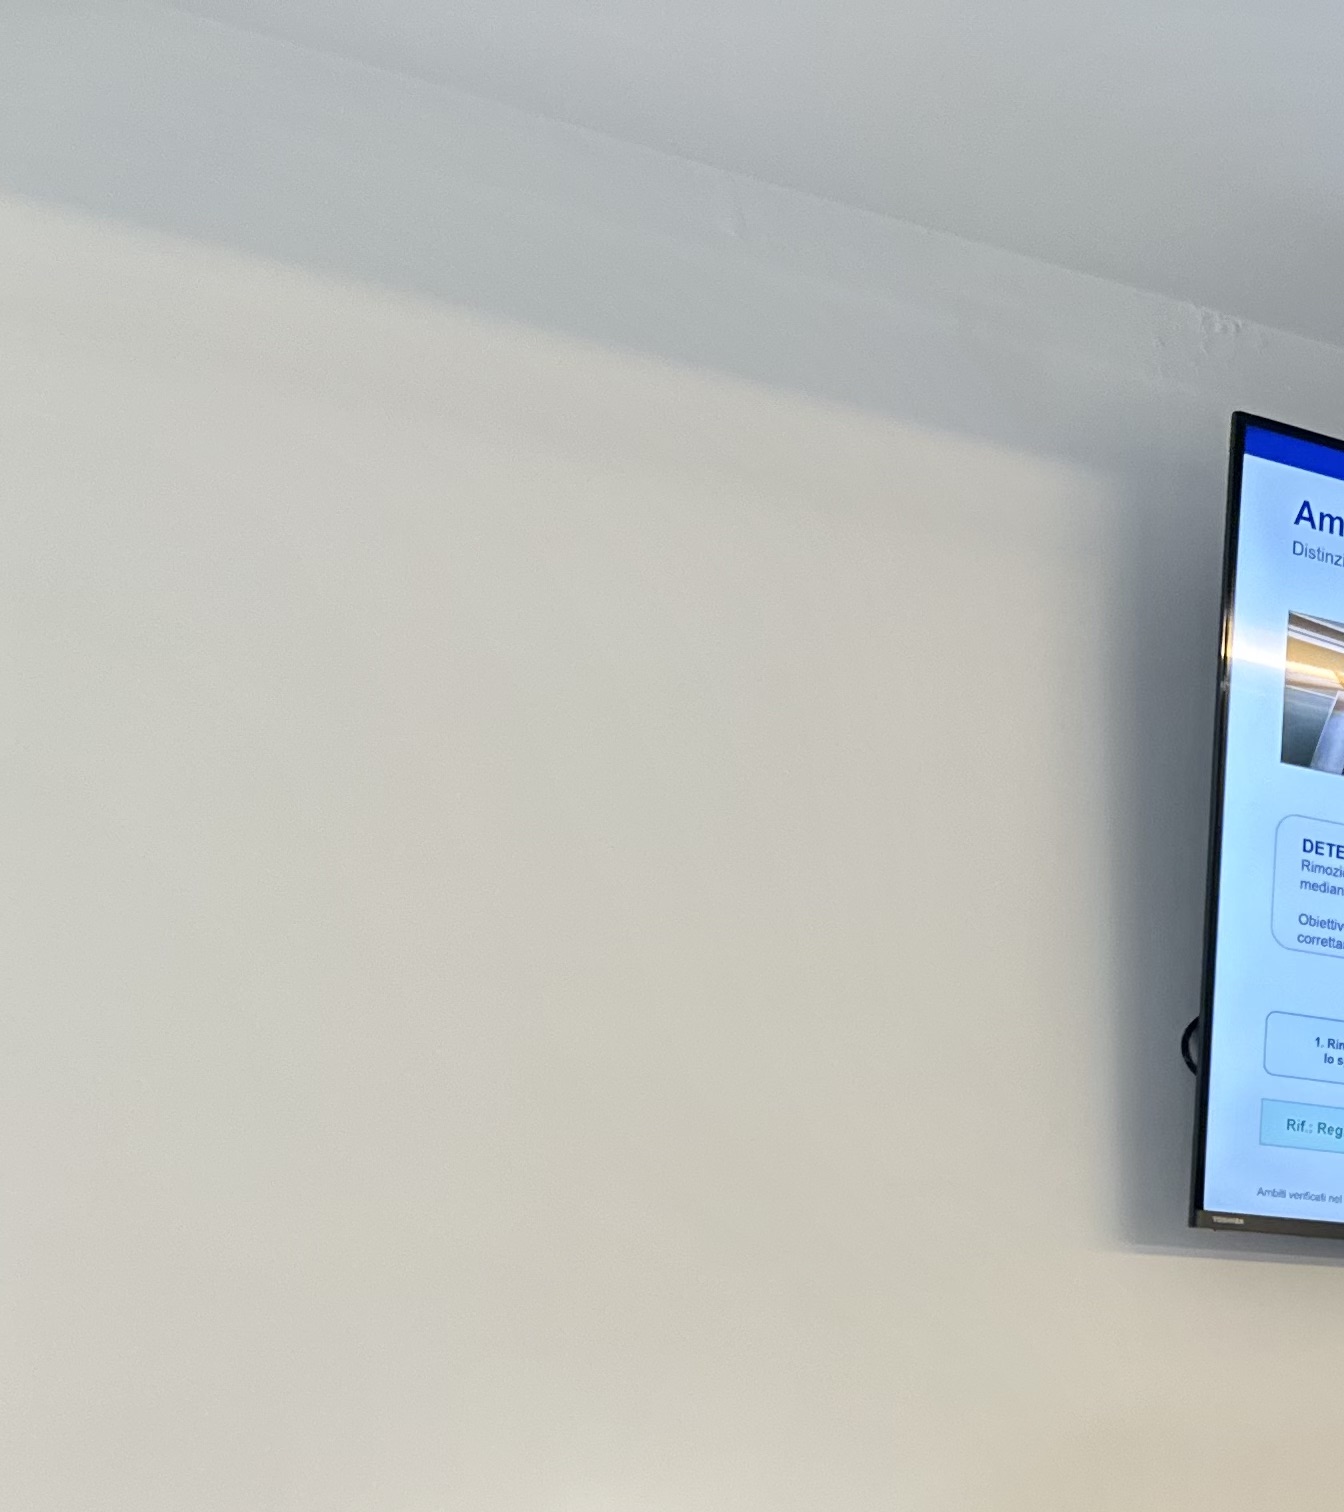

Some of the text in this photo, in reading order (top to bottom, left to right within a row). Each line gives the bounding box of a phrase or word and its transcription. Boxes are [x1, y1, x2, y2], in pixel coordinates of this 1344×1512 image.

[1315, 1037, 1324, 1048] 1.
[1324, 1053, 1334, 1064] lo
[1257, 1187, 1286, 1198] Ambiti
[1289, 1192, 1326, 1202] verificati
[1328, 1195, 1343, 1204] nel
